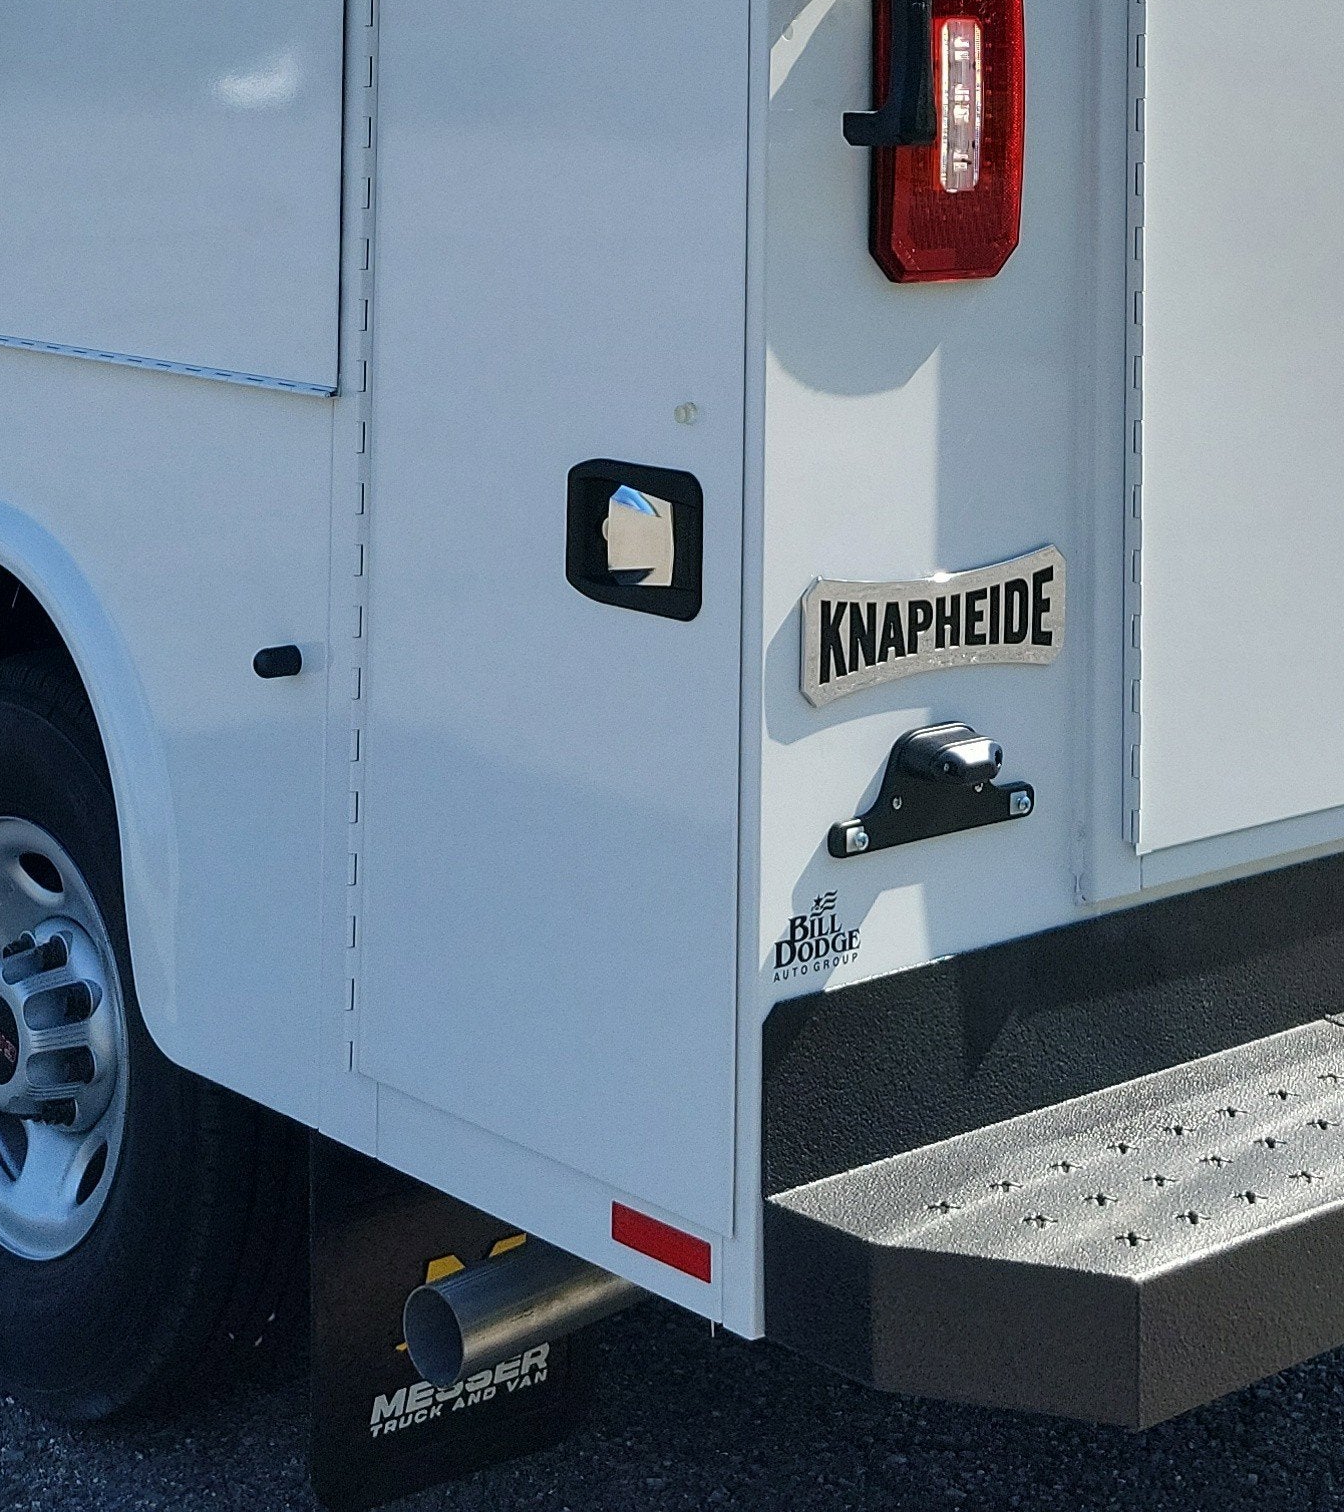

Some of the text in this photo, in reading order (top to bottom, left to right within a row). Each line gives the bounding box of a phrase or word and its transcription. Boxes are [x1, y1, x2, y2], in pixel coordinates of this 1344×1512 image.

[818, 565, 1054, 686] KNAPHEIDE
[773, 928, 861, 969] DODGE
[788, 913, 843, 943] BILL
[773, 952, 859, 983] AUTO GROUP
[370, 1368, 549, 1437] TRUCK AND VAN
